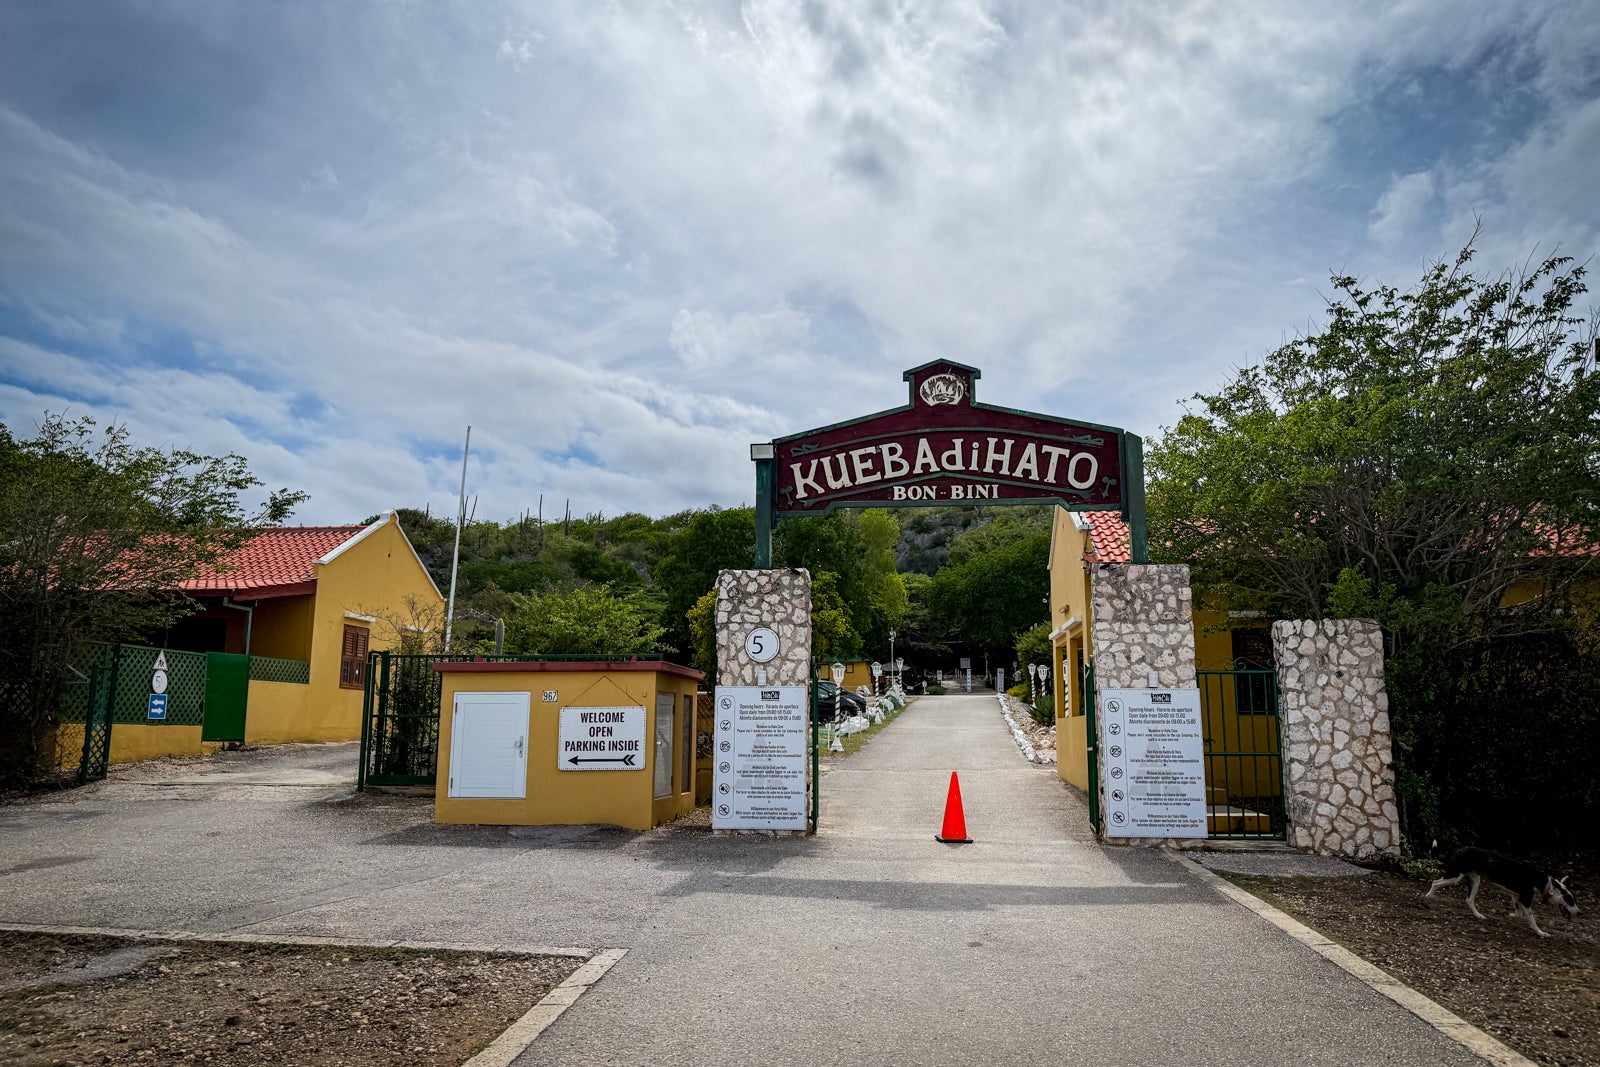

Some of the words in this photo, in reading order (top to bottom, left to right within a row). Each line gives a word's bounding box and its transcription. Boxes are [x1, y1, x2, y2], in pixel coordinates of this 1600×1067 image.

[892, 486, 938, 501] BON
[950, 484, 999, 500] BINI
[751, 635, 763, 654] 5
[543, 691, 557, 701] 967
[580, 712, 625, 723] WELCOME
[589, 726, 613, 737] OPEN
[565, 740, 606, 752] PARKING
[608, 740, 640, 751] INSIDE
